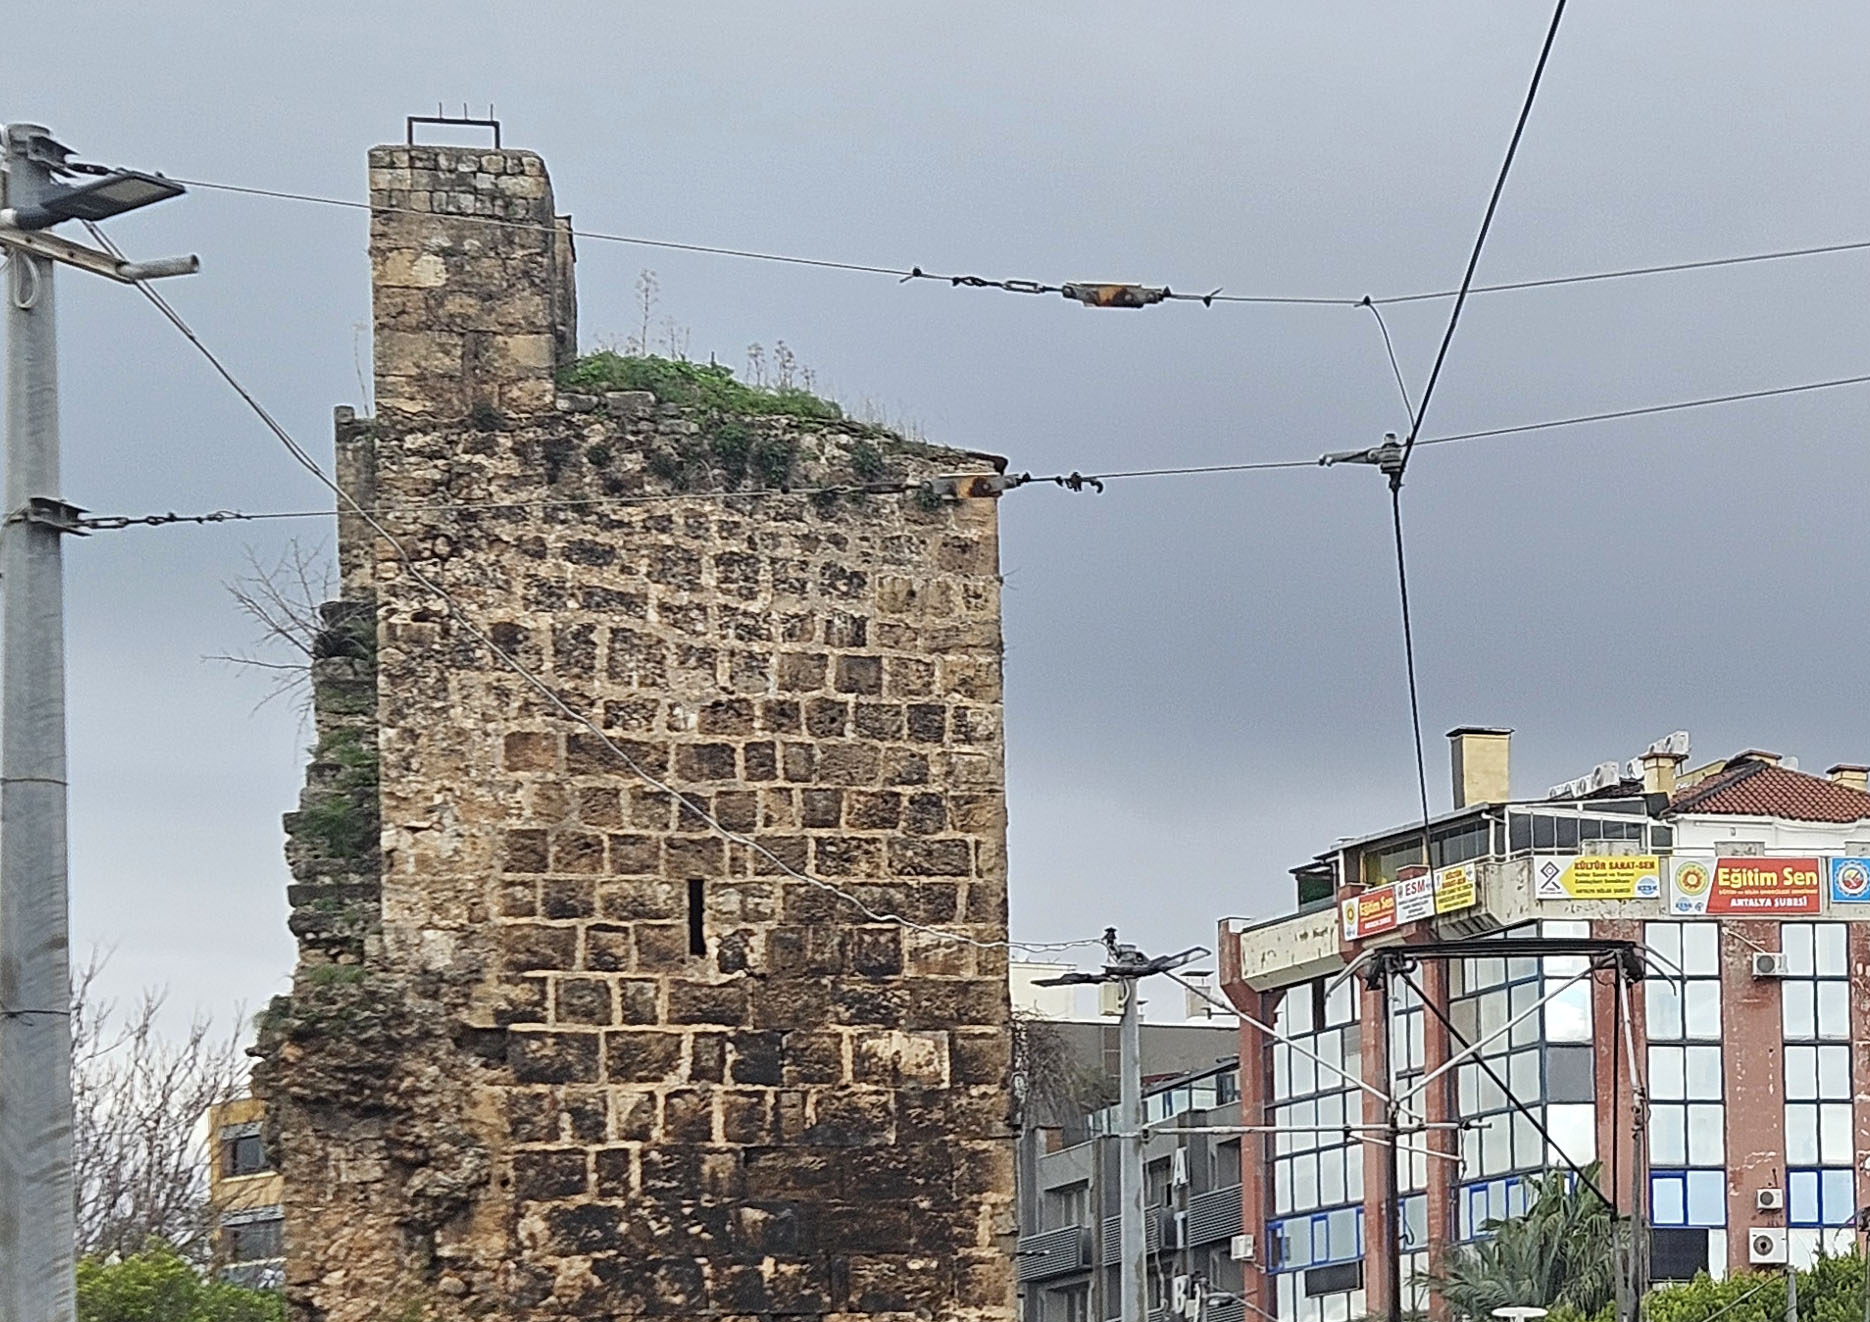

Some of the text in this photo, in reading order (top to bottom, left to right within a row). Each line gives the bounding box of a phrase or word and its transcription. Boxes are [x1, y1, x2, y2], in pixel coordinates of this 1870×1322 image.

[1718, 867, 1777, 888] Eğitim
[1782, 867, 1818, 886] Sen
[1405, 879, 1426, 897] ESM
[1730, 897, 1772, 907] ANTALYA
